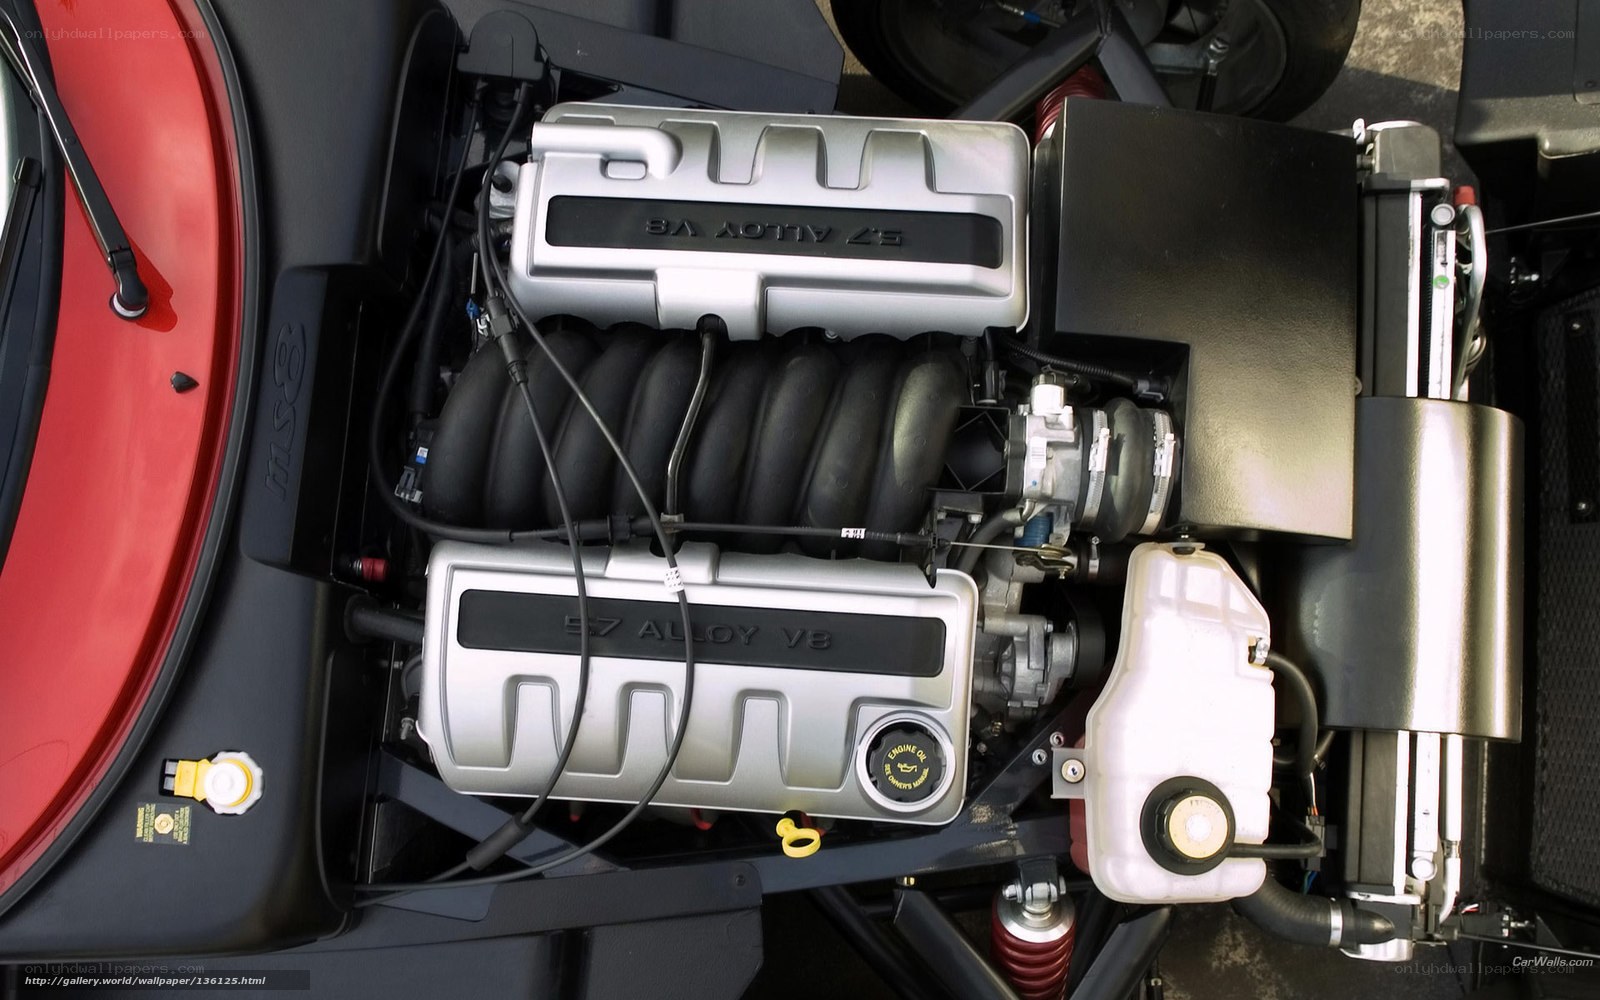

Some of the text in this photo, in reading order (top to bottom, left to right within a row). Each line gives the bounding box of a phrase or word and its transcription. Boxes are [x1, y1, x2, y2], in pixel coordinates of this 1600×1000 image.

[645, 216, 902, 245] 5.7 ALLOY V8
[782, 627, 832, 649] V8
[888, 744, 927, 763] ENGINE OIL
